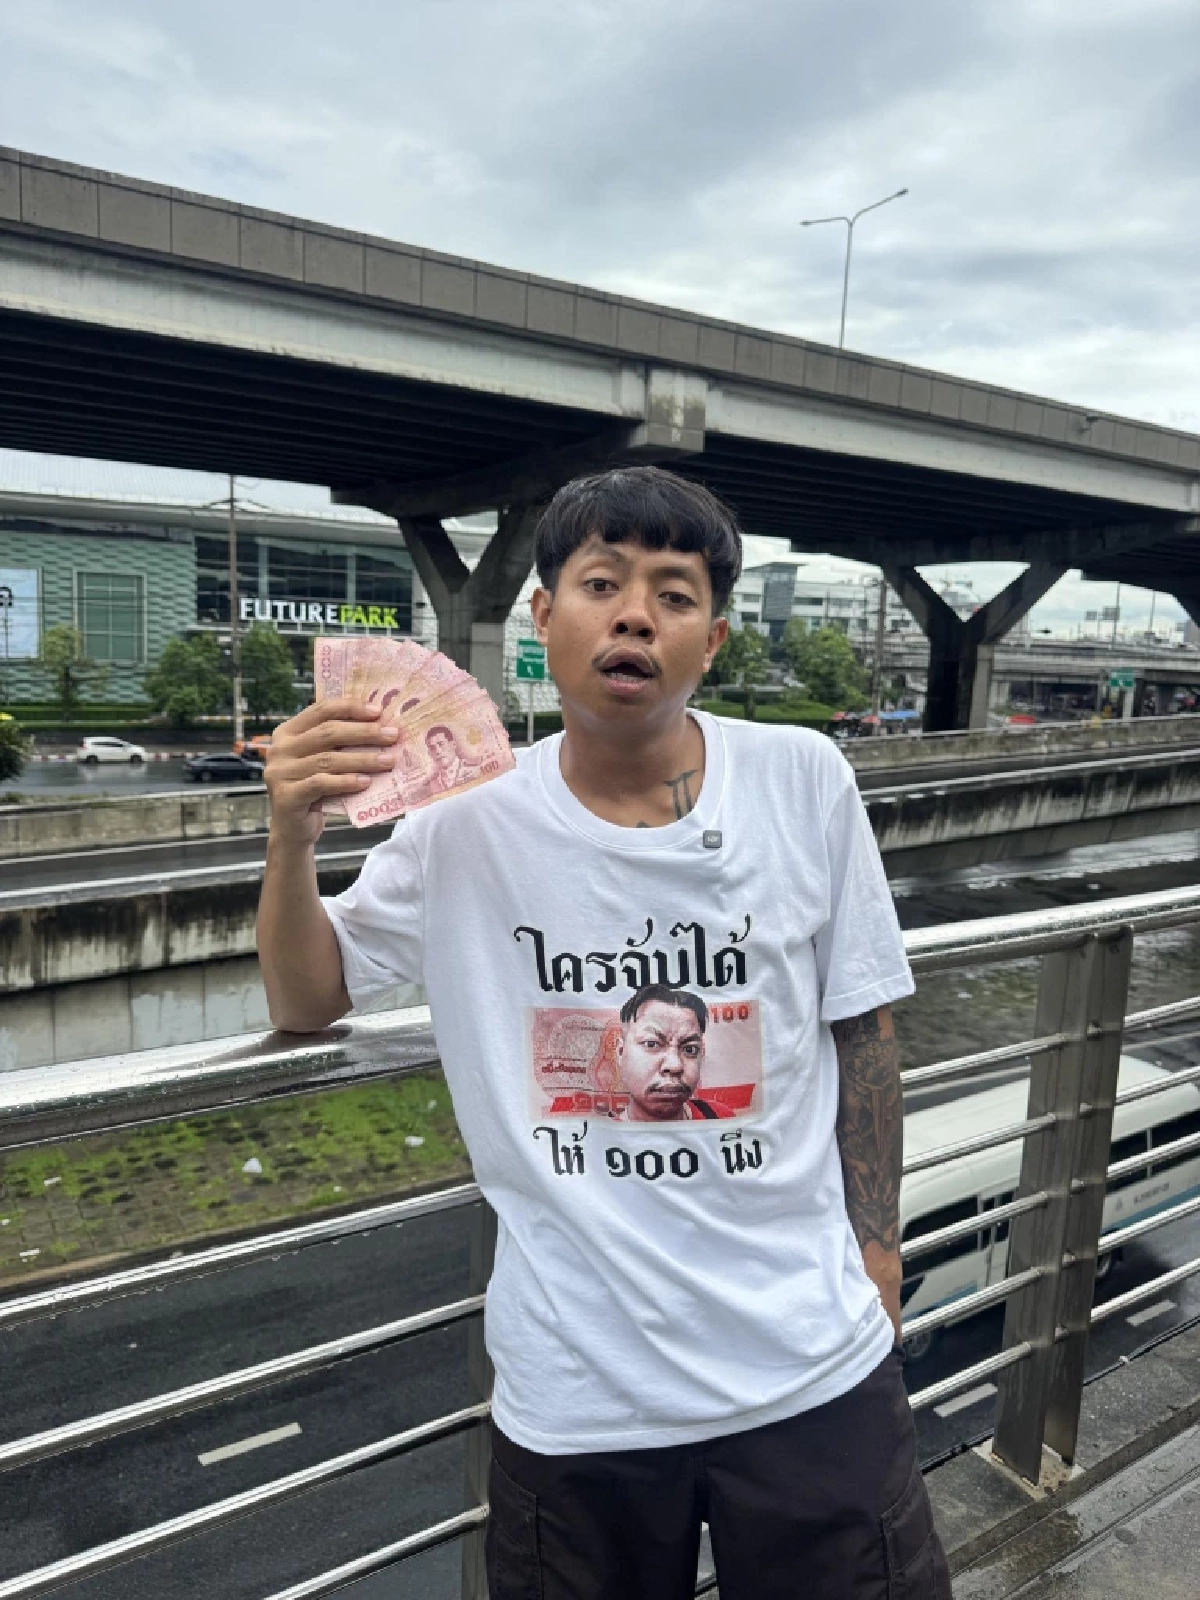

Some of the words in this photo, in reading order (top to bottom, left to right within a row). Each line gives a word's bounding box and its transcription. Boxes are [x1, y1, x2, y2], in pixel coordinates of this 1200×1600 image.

[513, 914, 751, 993] ใครจับได้
[710, 1003, 750, 1024] 100
[532, 1120, 588, 1176] ให้
[605, 1147, 700, 1181] ๑๐๐
